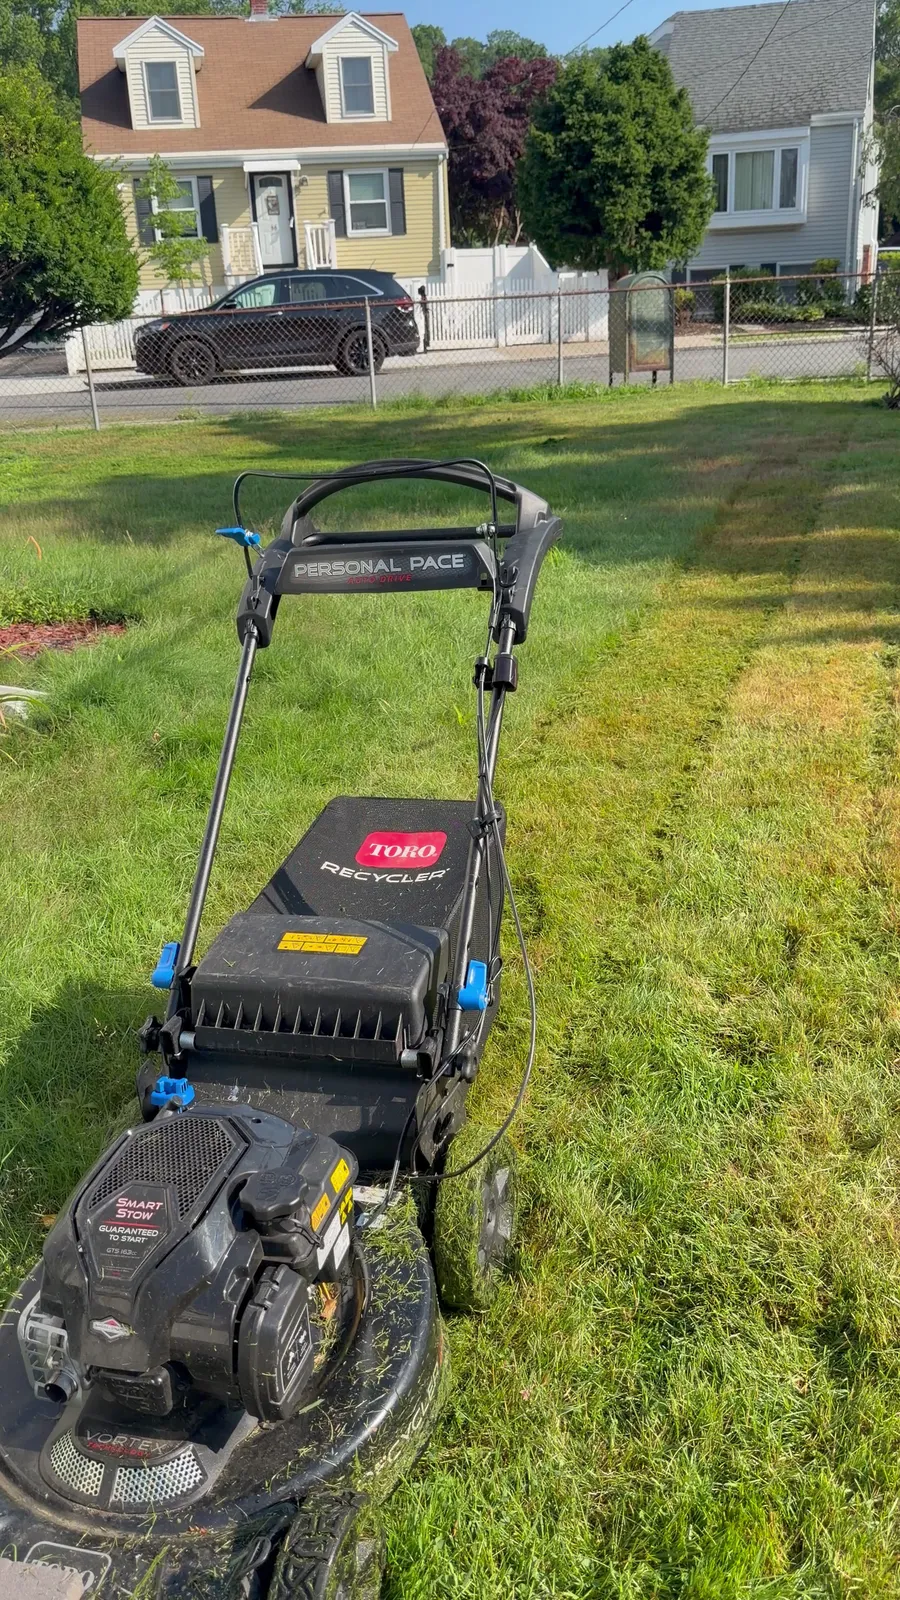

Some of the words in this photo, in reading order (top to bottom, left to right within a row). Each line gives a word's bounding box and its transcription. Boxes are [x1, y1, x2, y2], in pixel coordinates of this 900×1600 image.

[294, 557, 402, 578] PERSONAL
[409, 553, 465, 571] PACE
[346, 575, 376, 585] AUTO
[379, 574, 413, 583] DRIVE
[369, 843, 435, 859] TORO
[320, 861, 448, 883] RECYCLER
[115, 1197, 164, 1211] SMART
[115, 1208, 154, 1221] STOW
[98, 1224, 159, 1238] GUARANTEED
[120, 1235, 146, 1244] START
[86, 1429, 168, 1455] VORTEX
